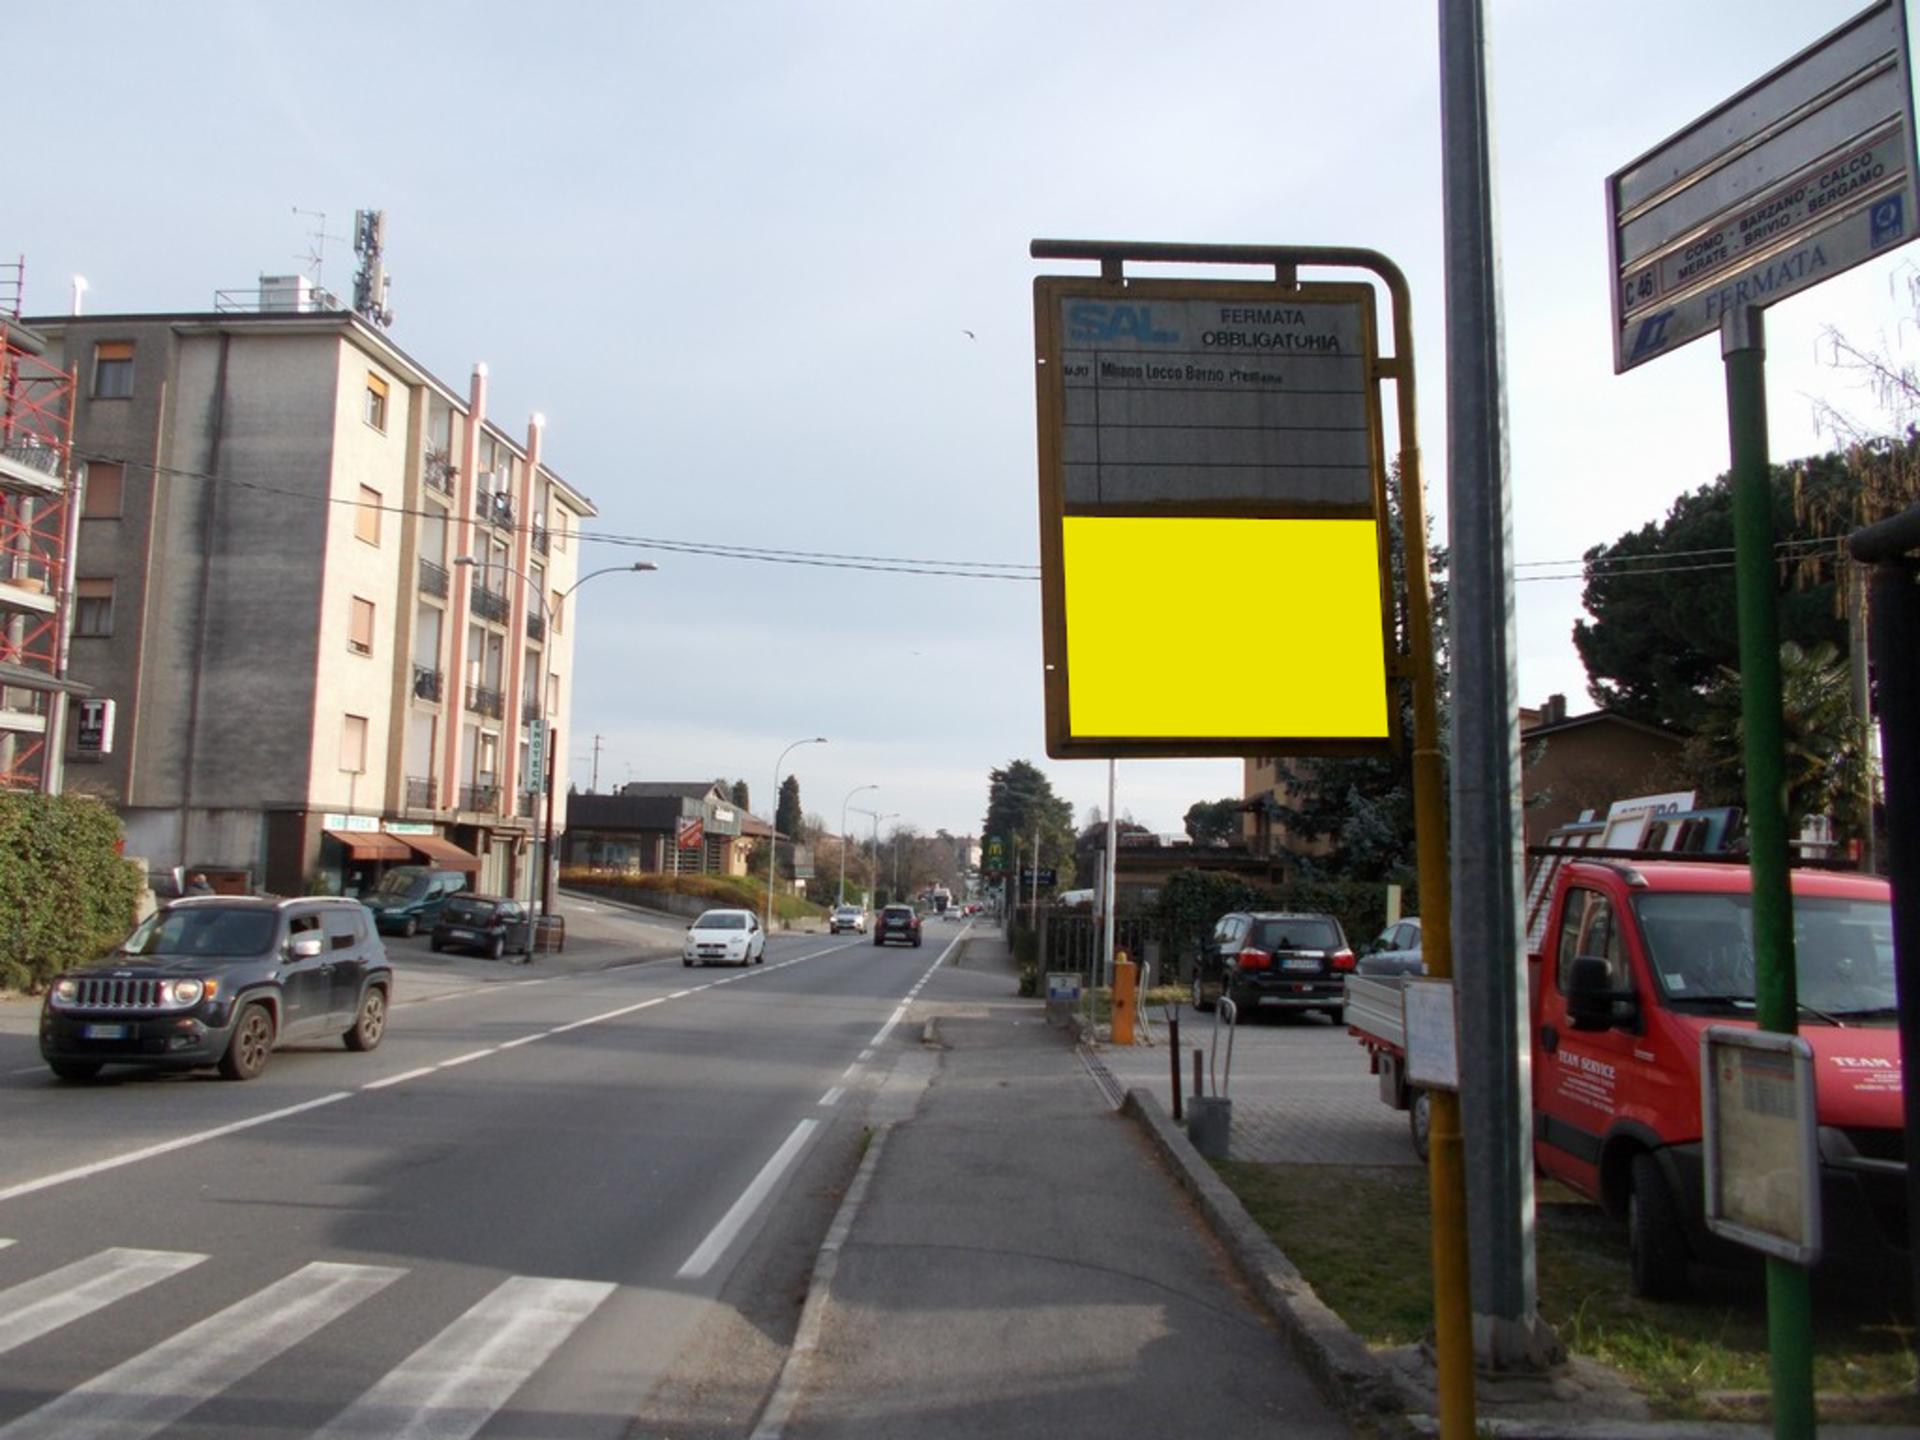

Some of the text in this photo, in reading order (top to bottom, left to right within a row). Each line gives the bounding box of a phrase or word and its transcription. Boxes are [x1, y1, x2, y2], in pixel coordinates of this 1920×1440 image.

[1677, 164, 1885, 280] MERATE BRIVIO BERGAMO
[1685, 232, 1724, 262] COMO
[1819, 152, 1873, 188] CALCO
[1625, 281, 1634, 306] C
[1704, 244, 1828, 320] FERMATA
[1068, 303, 1180, 344] SAL
[1220, 308, 1306, 327] FERMATA
[1146, 362, 1183, 380] Lecco
[530, 721, 541, 787] ENOTECA
[1580, 1057, 1616, 1079] SERVICE
[1829, 1056, 1892, 1068] TEAM
